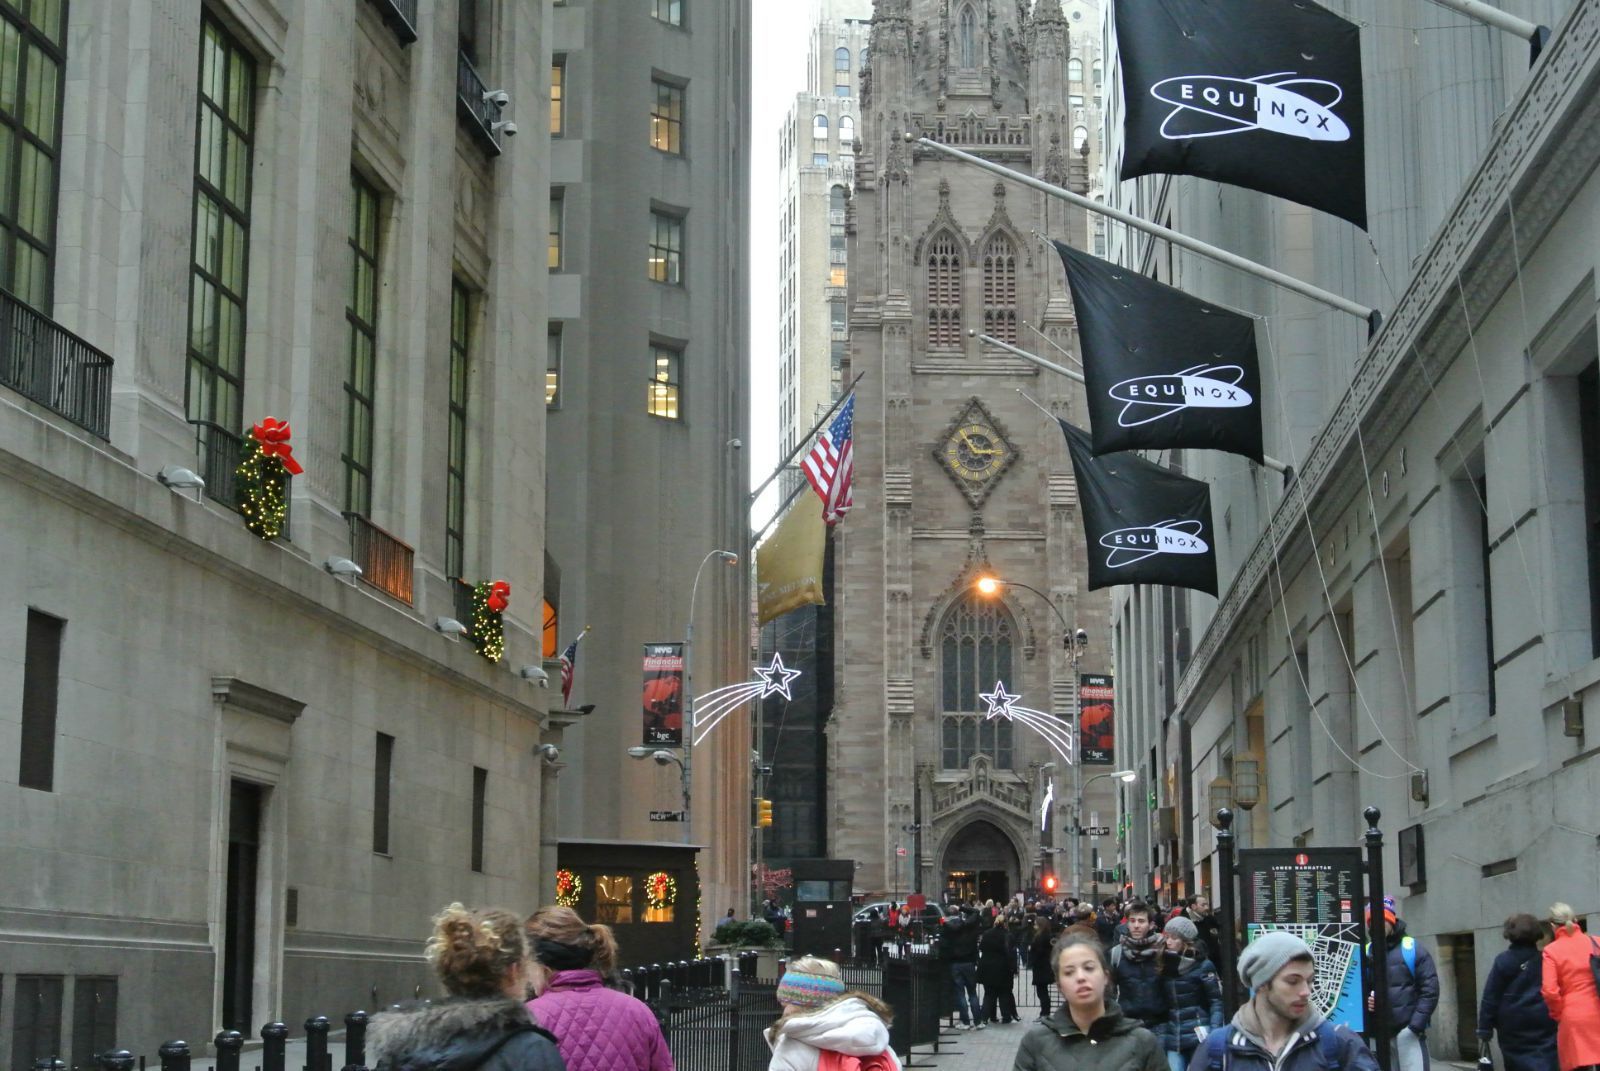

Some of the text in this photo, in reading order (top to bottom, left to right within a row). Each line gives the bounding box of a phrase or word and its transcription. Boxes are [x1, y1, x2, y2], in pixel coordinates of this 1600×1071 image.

[1181, 84, 1330, 132] EQUINOX
[1129, 384, 1238, 401] EQUINOX
[1115, 534, 1198, 549] EQUINOX
[654, 646, 673, 654] NYC
